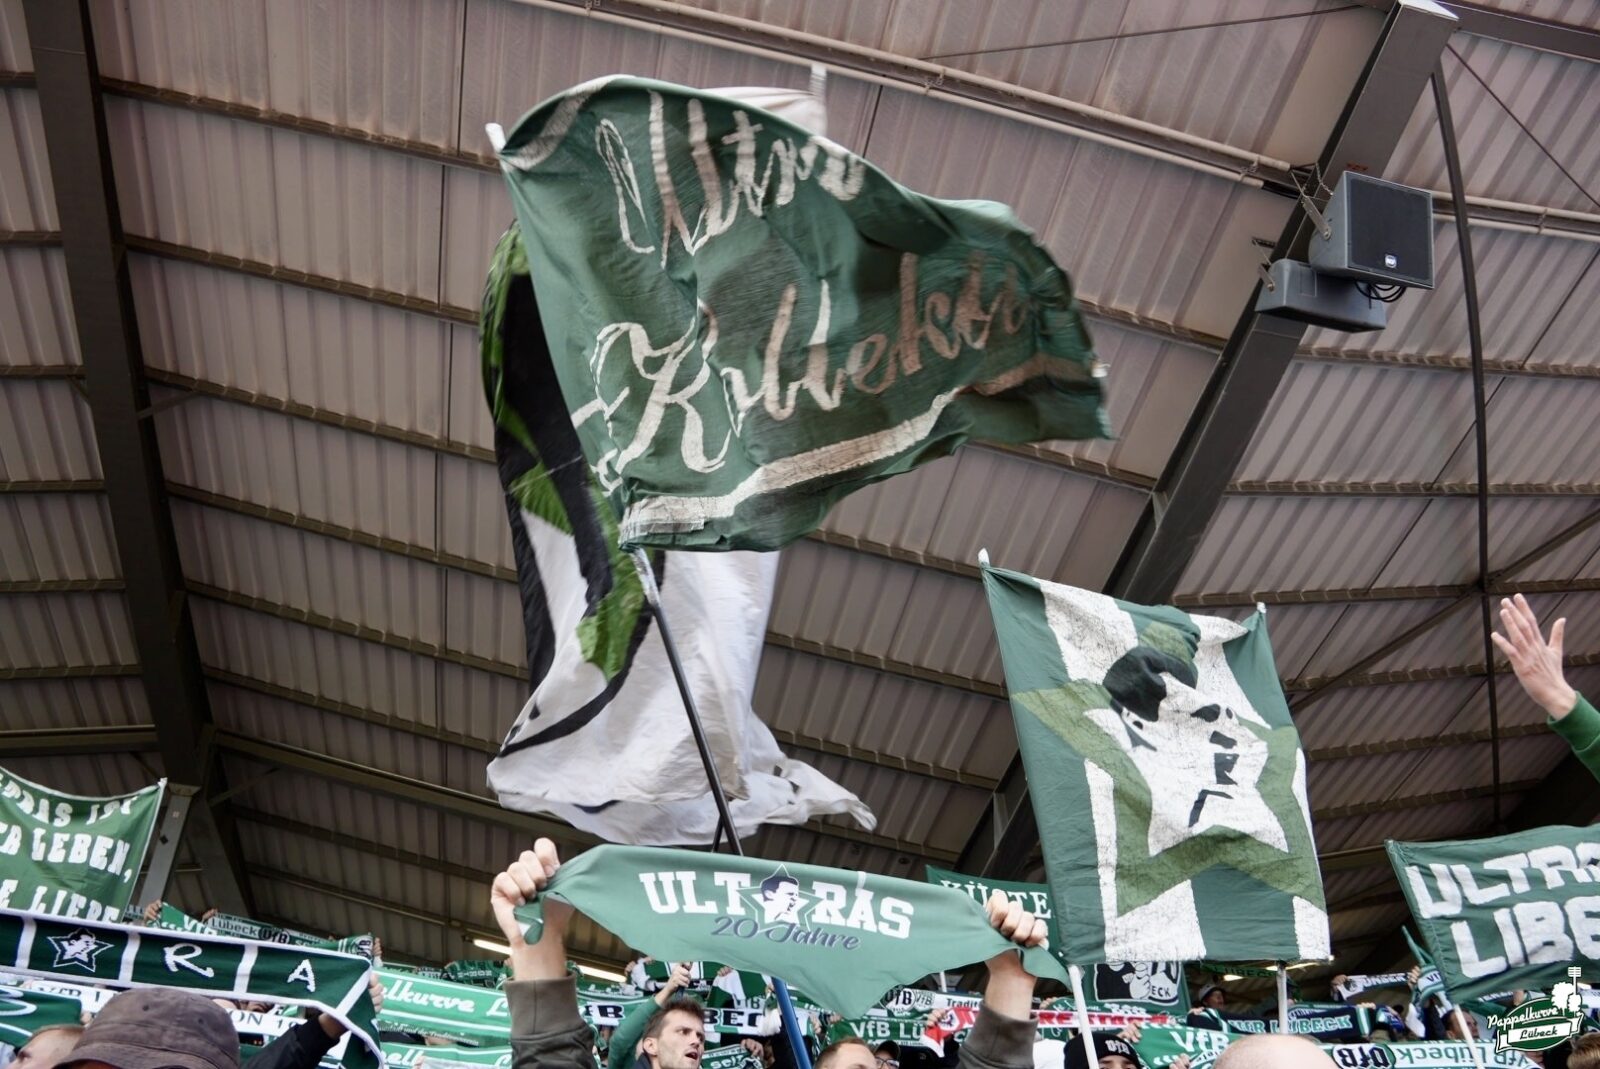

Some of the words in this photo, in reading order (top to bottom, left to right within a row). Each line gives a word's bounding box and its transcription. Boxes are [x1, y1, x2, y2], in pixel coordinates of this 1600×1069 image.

[31, 826, 133, 884] LEBEN,
[711, 916, 759, 940] 20
[764, 922, 861, 951] Jahre
[946, 997, 981, 1011] Tradit
[850, 1020, 890, 1039] VfB
